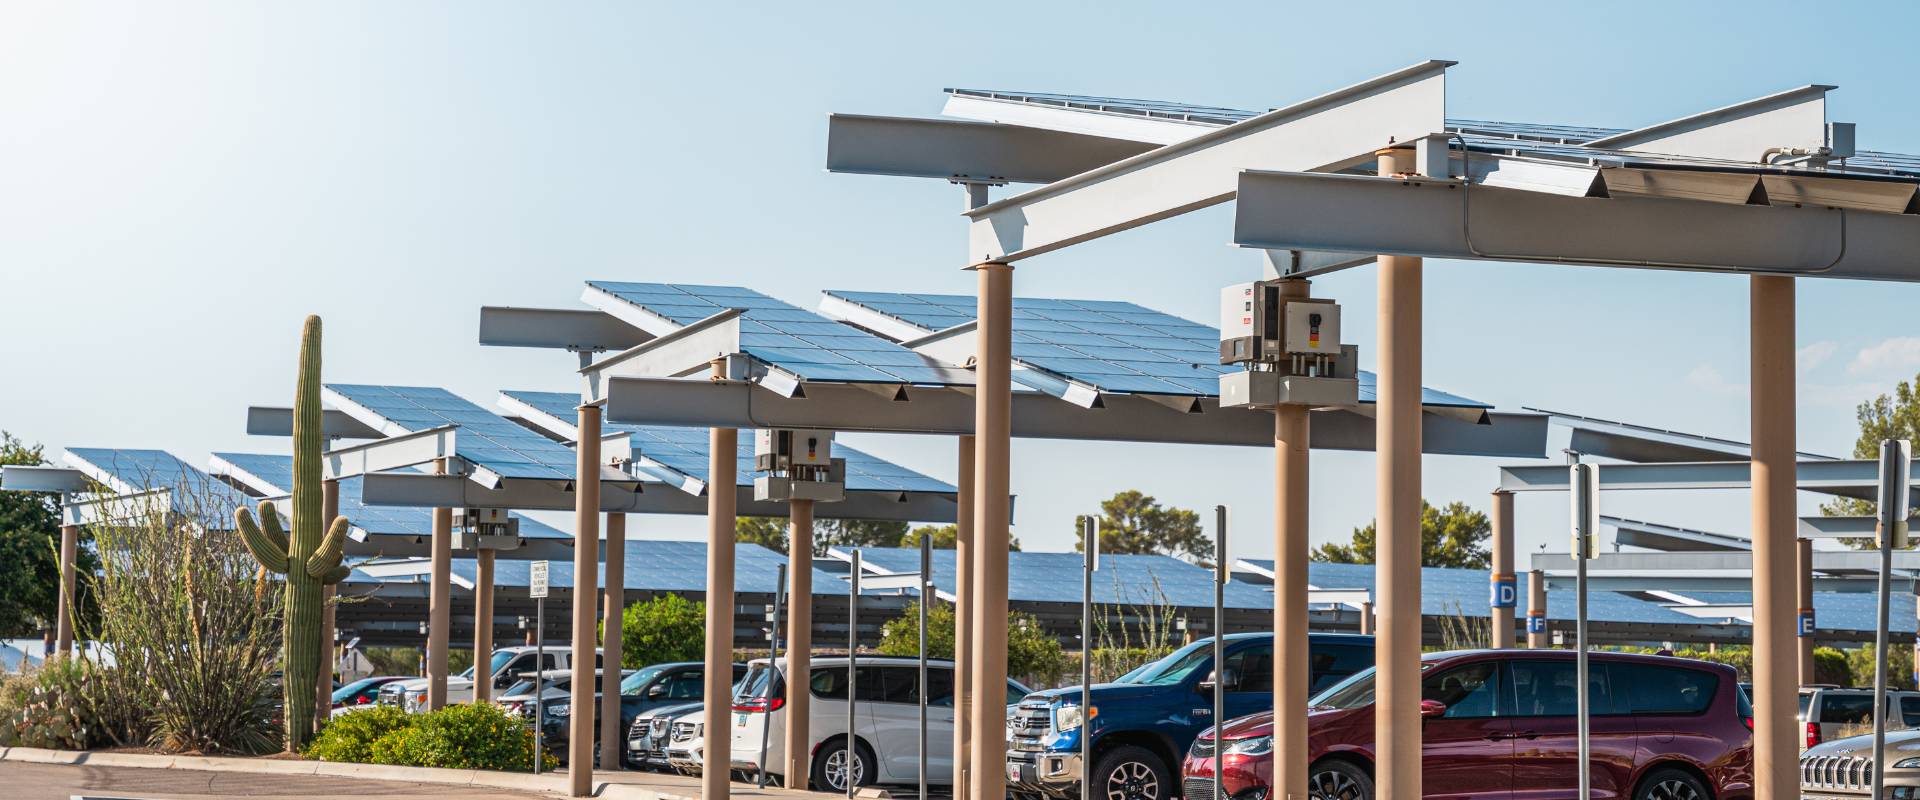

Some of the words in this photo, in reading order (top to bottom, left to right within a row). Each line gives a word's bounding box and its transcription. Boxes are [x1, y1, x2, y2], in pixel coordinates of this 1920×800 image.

[1501, 585, 1514, 603] D
[1535, 618, 1544, 630] F
[1803, 618, 1813, 633] E
